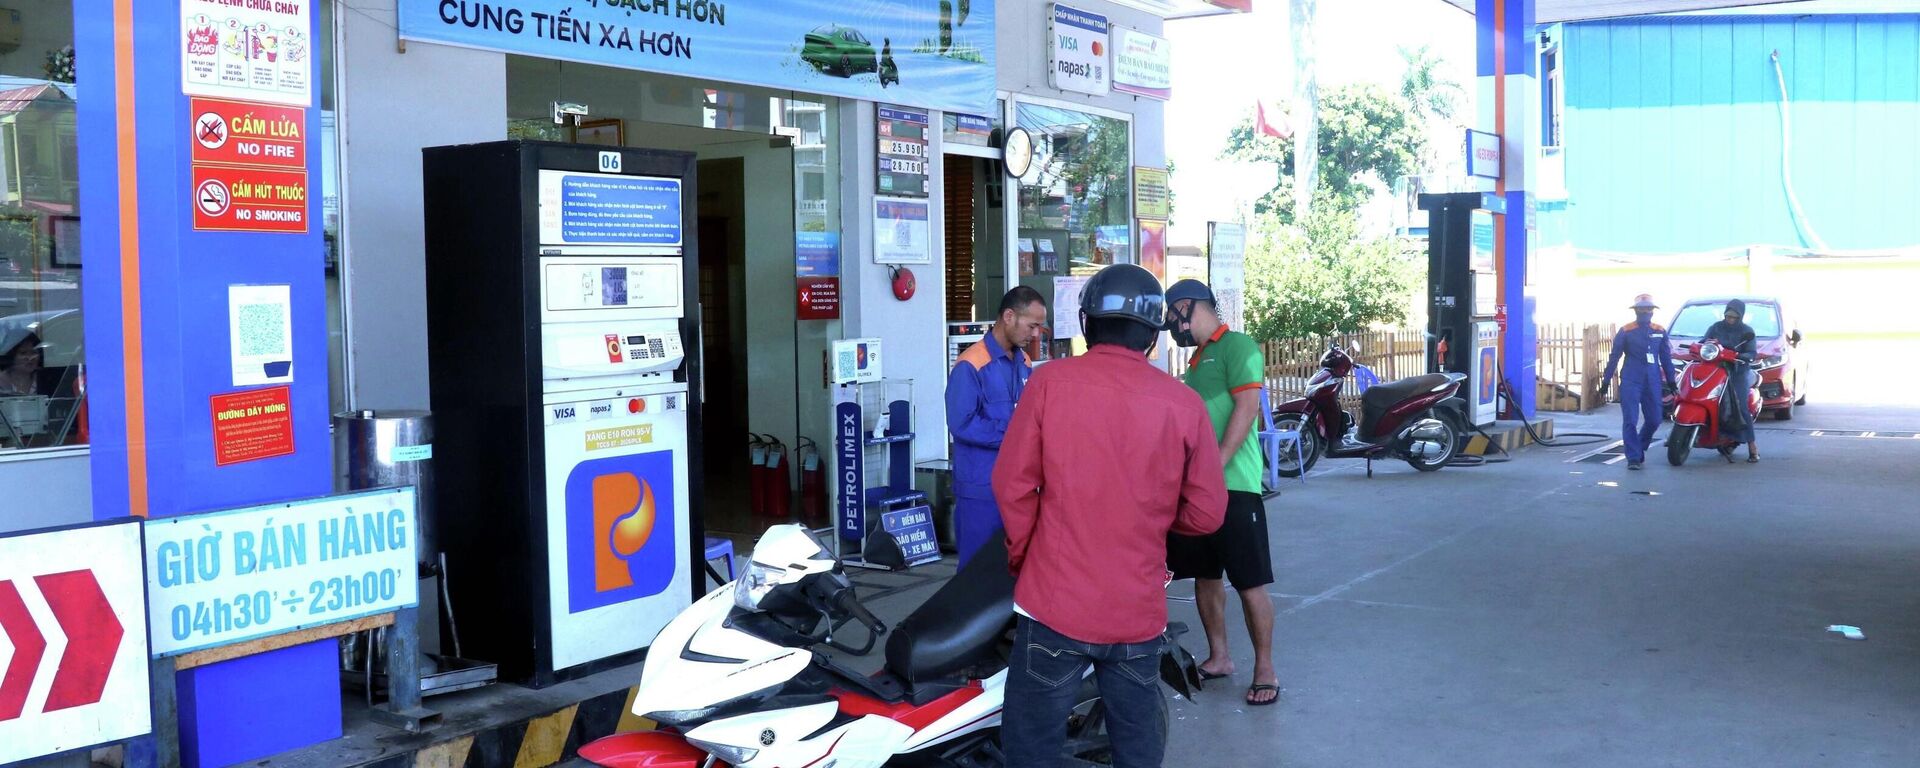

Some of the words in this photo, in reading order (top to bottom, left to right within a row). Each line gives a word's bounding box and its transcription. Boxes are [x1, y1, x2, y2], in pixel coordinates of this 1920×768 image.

[275, 2, 299, 15] CHÁY
[1080, 16, 1094, 25] THANH
[531, 7, 590, 44] TIẾN
[599, 22, 634, 50] XA
[639, 30, 691, 59] HƠN
[1059, 35, 1078, 51] VISA
[1059, 60, 1084, 77] napas
[232, 112, 265, 134] CẤM
[271, 114, 299, 137] LỬA
[238, 143, 259, 155] NO
[264, 145, 295, 157] FIRE
[892, 142, 920, 155] 25.950
[601, 154, 619, 169] 06
[892, 160, 920, 172] 28.760
[232, 179, 251, 198] CẤM
[255, 181, 272, 198] HÚT
[275, 182, 304, 200] THUỐC
[236, 209, 251, 220] NO
[255, 210, 301, 221] SMOKING
[218, 408, 245, 420] ĐƯỜNG
[247, 405, 262, 417] DÂY
[264, 403, 286, 414] NÓNG
[554, 407, 575, 419] VISA
[590, 405, 608, 414] napas
[586, 431, 606, 442] XĂNG
[608, 430, 619, 439] E10
[620, 428, 635, 437] RON
[846, 413, 858, 530] PETROLIMEX
[902, 512, 915, 526] ĐIỂM
[915, 512, 926, 523] BÁN
[910, 529, 927, 542] HIỂM
[158, 524, 222, 589] GIỜ
[234, 517, 306, 575] BÁN
[320, 507, 406, 562] HÀNG
[912, 544, 920, 555] XE
[921, 538, 935, 552] MÁY
